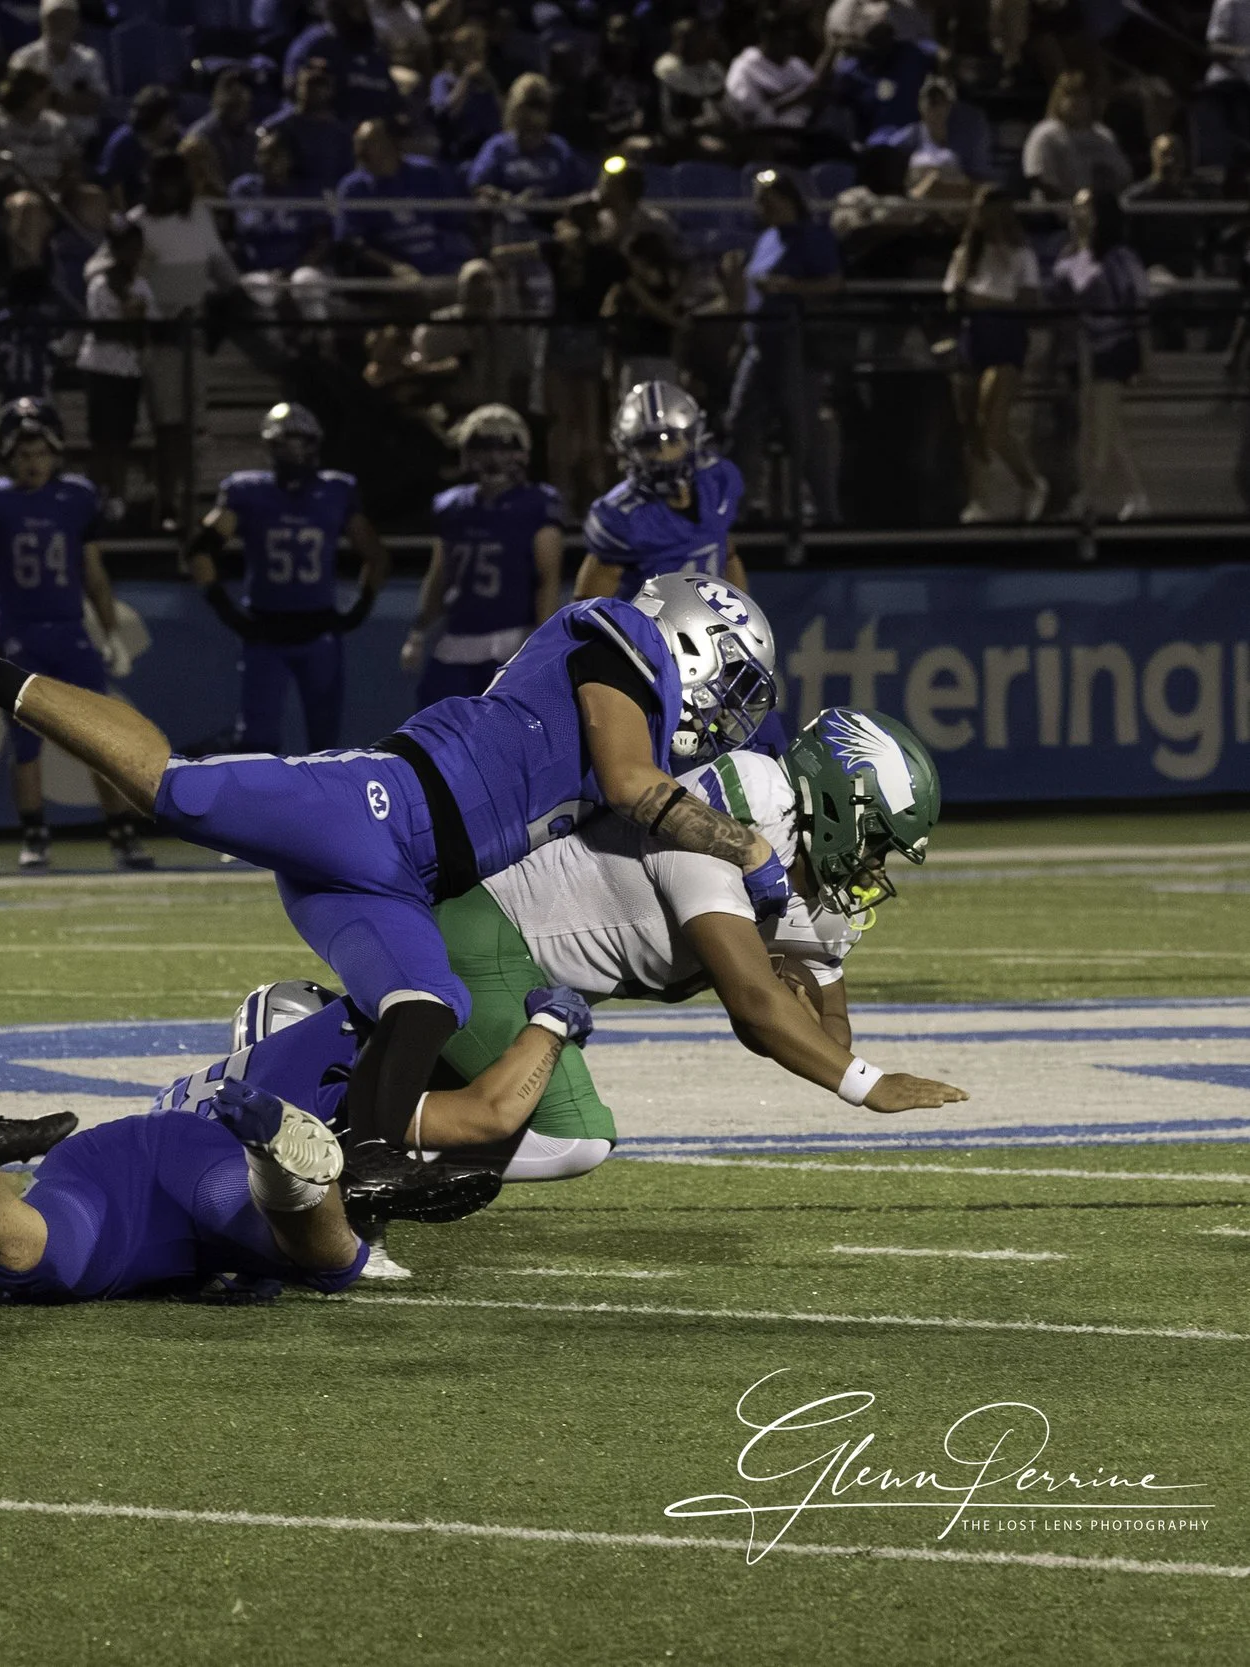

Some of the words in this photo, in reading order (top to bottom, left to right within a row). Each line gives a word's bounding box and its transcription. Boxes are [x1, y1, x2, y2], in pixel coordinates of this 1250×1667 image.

[12, 531, 69, 590] 64
[266, 526, 325, 584] 53
[696, 581, 748, 624] M
[369, 785, 387, 815] M
